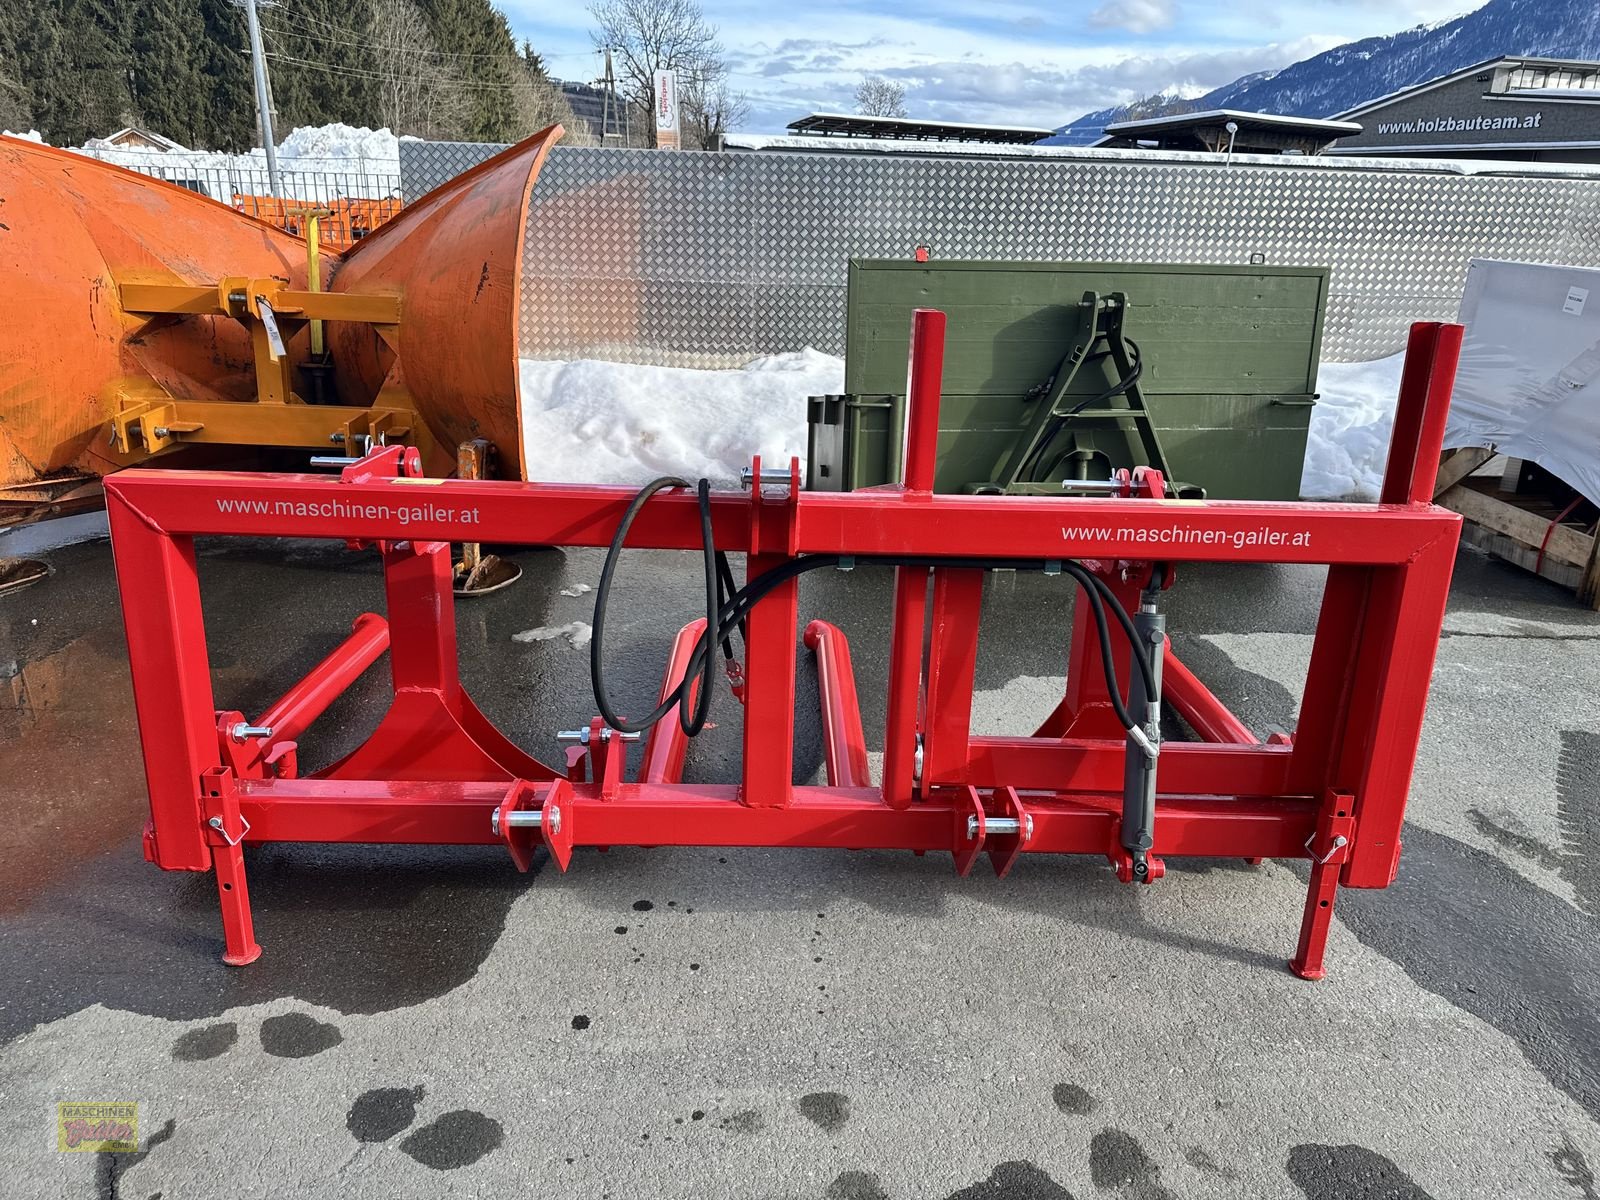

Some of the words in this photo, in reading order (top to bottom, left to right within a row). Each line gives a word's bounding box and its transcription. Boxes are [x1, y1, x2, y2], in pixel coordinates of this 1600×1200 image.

[1378, 112, 1541, 134] www.holzbauteam.at
[216, 499, 480, 525] www.maschinen-gailer.at
[1061, 525, 1311, 548] www.maschinen-gailer.at
